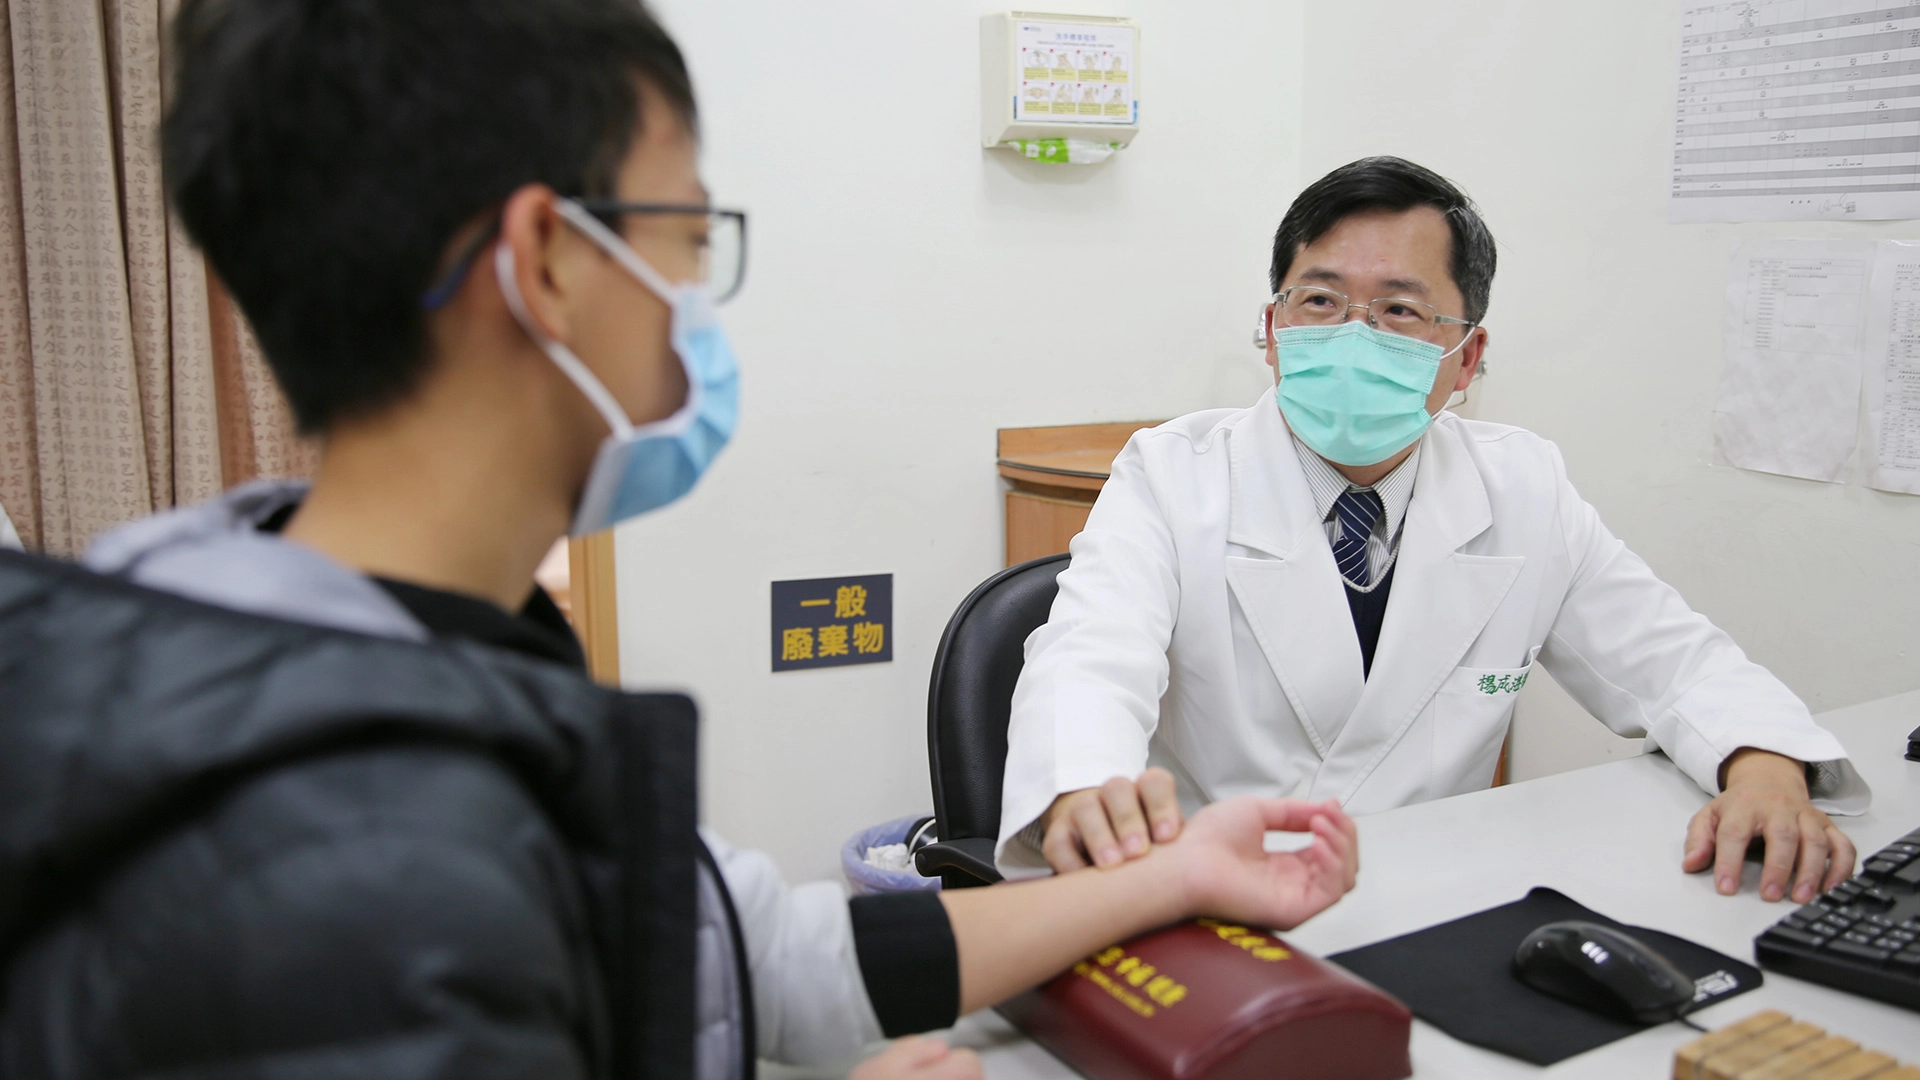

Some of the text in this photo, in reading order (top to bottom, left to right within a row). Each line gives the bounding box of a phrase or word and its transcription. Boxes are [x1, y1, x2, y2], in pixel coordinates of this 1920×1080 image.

[800, 585, 867, 618] 一般
[782, 621, 884, 661] 廢棄物
